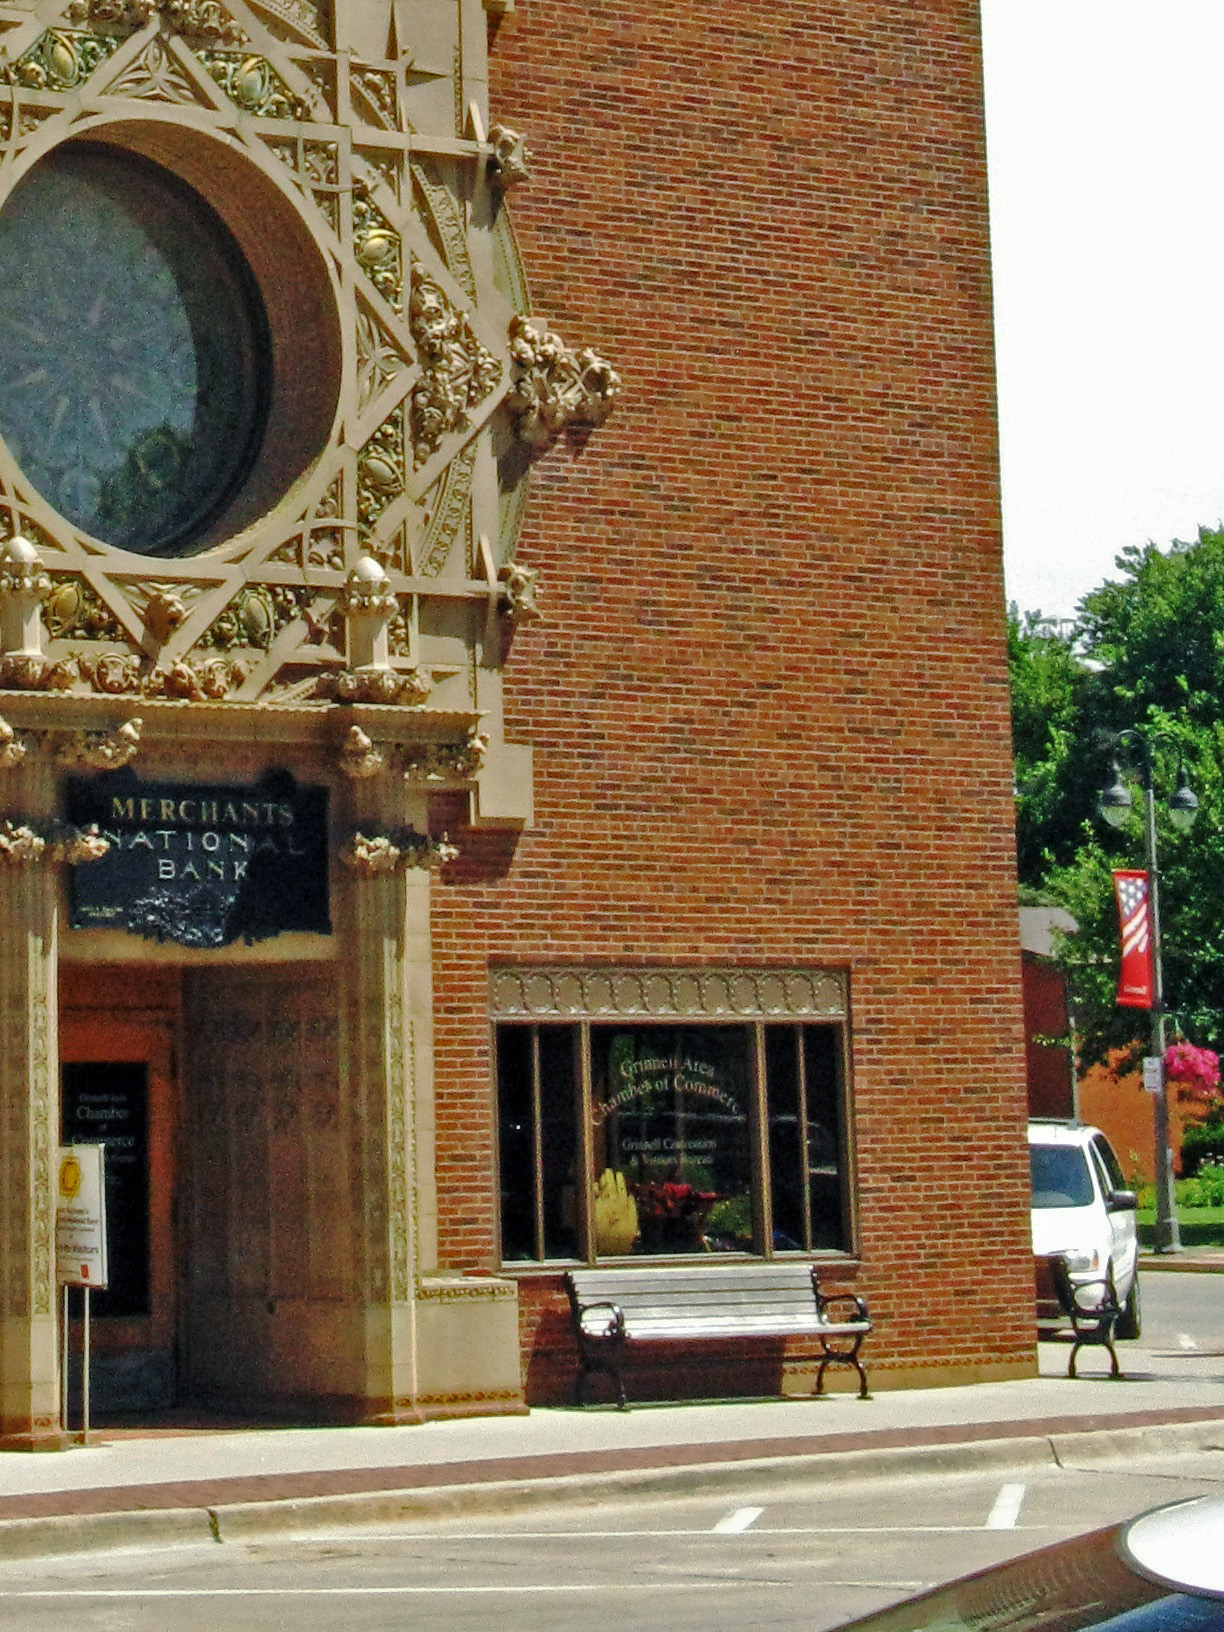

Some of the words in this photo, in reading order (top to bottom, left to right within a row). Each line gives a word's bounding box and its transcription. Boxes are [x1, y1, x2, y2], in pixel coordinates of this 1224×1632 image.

[112, 796, 293, 826] MERCHANTS
[104, 828, 305, 855] NATIONAL
[158, 858, 248, 881] BANK
[674, 1073, 740, 1115] Commerc
